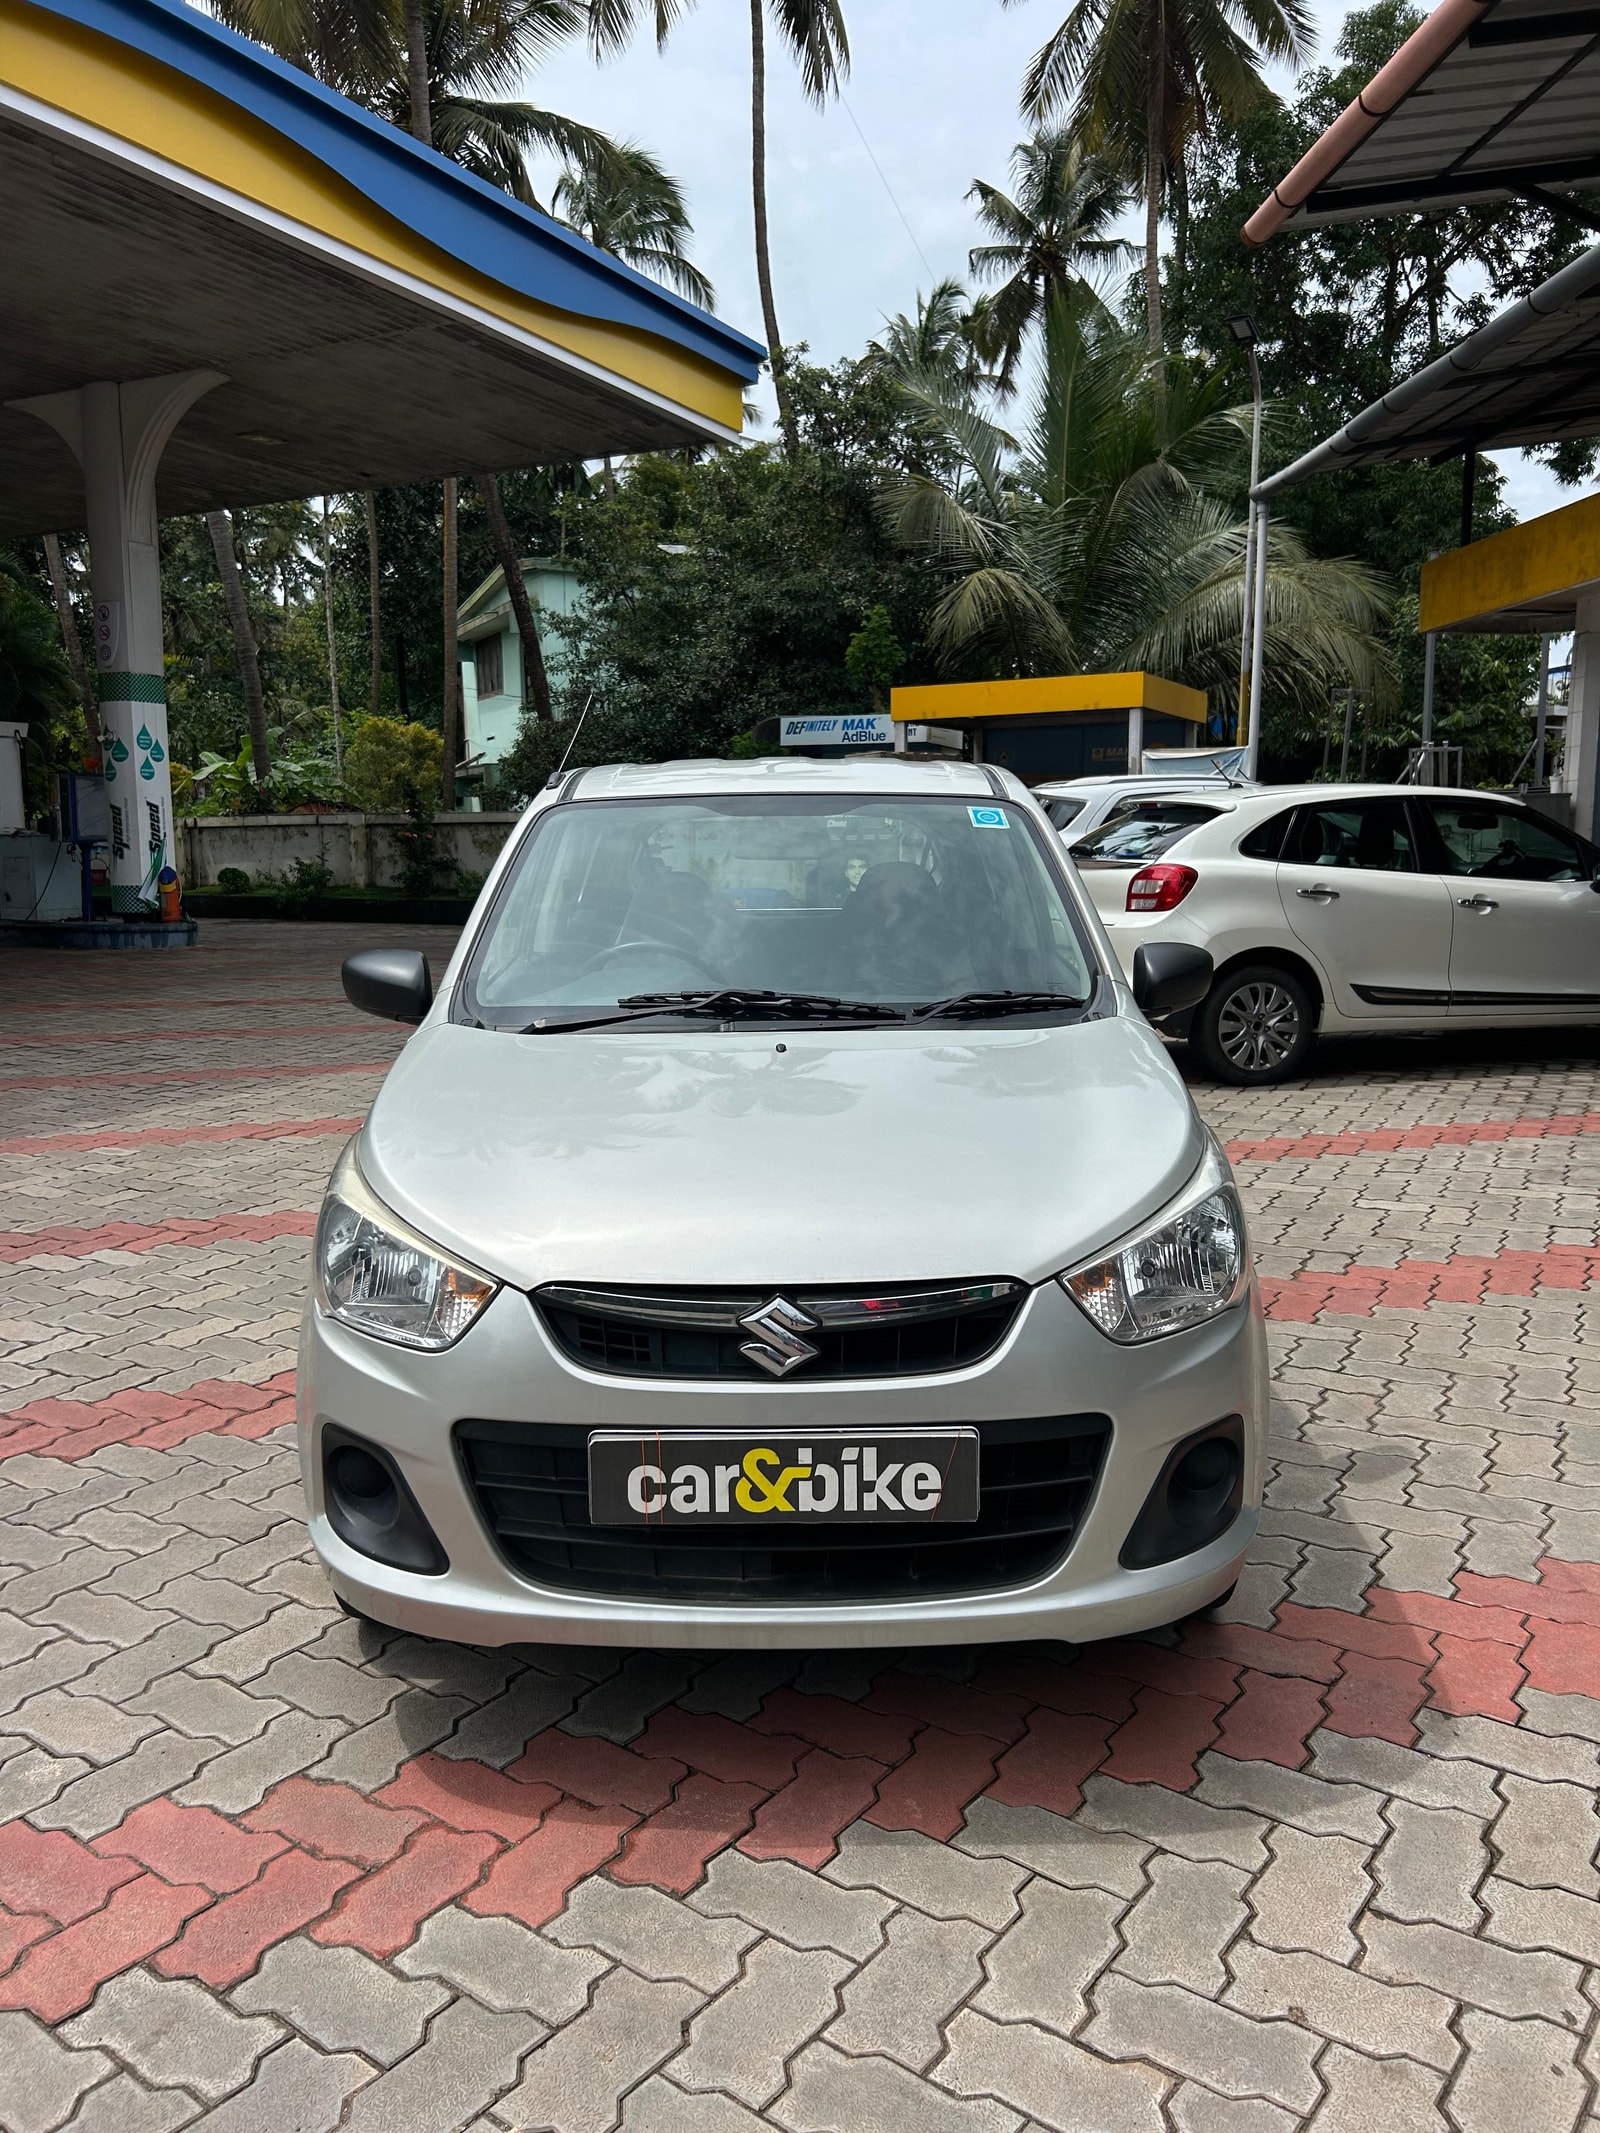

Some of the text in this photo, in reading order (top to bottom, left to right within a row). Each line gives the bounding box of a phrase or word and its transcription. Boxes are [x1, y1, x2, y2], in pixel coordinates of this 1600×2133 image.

[786, 718, 877, 735] DEFINITELY MAK
[842, 731, 886, 742] AdBlue
[109, 803, 131, 860] Speed
[146, 800, 163, 854] Speed
[627, 1446, 942, 1513] car&bike
